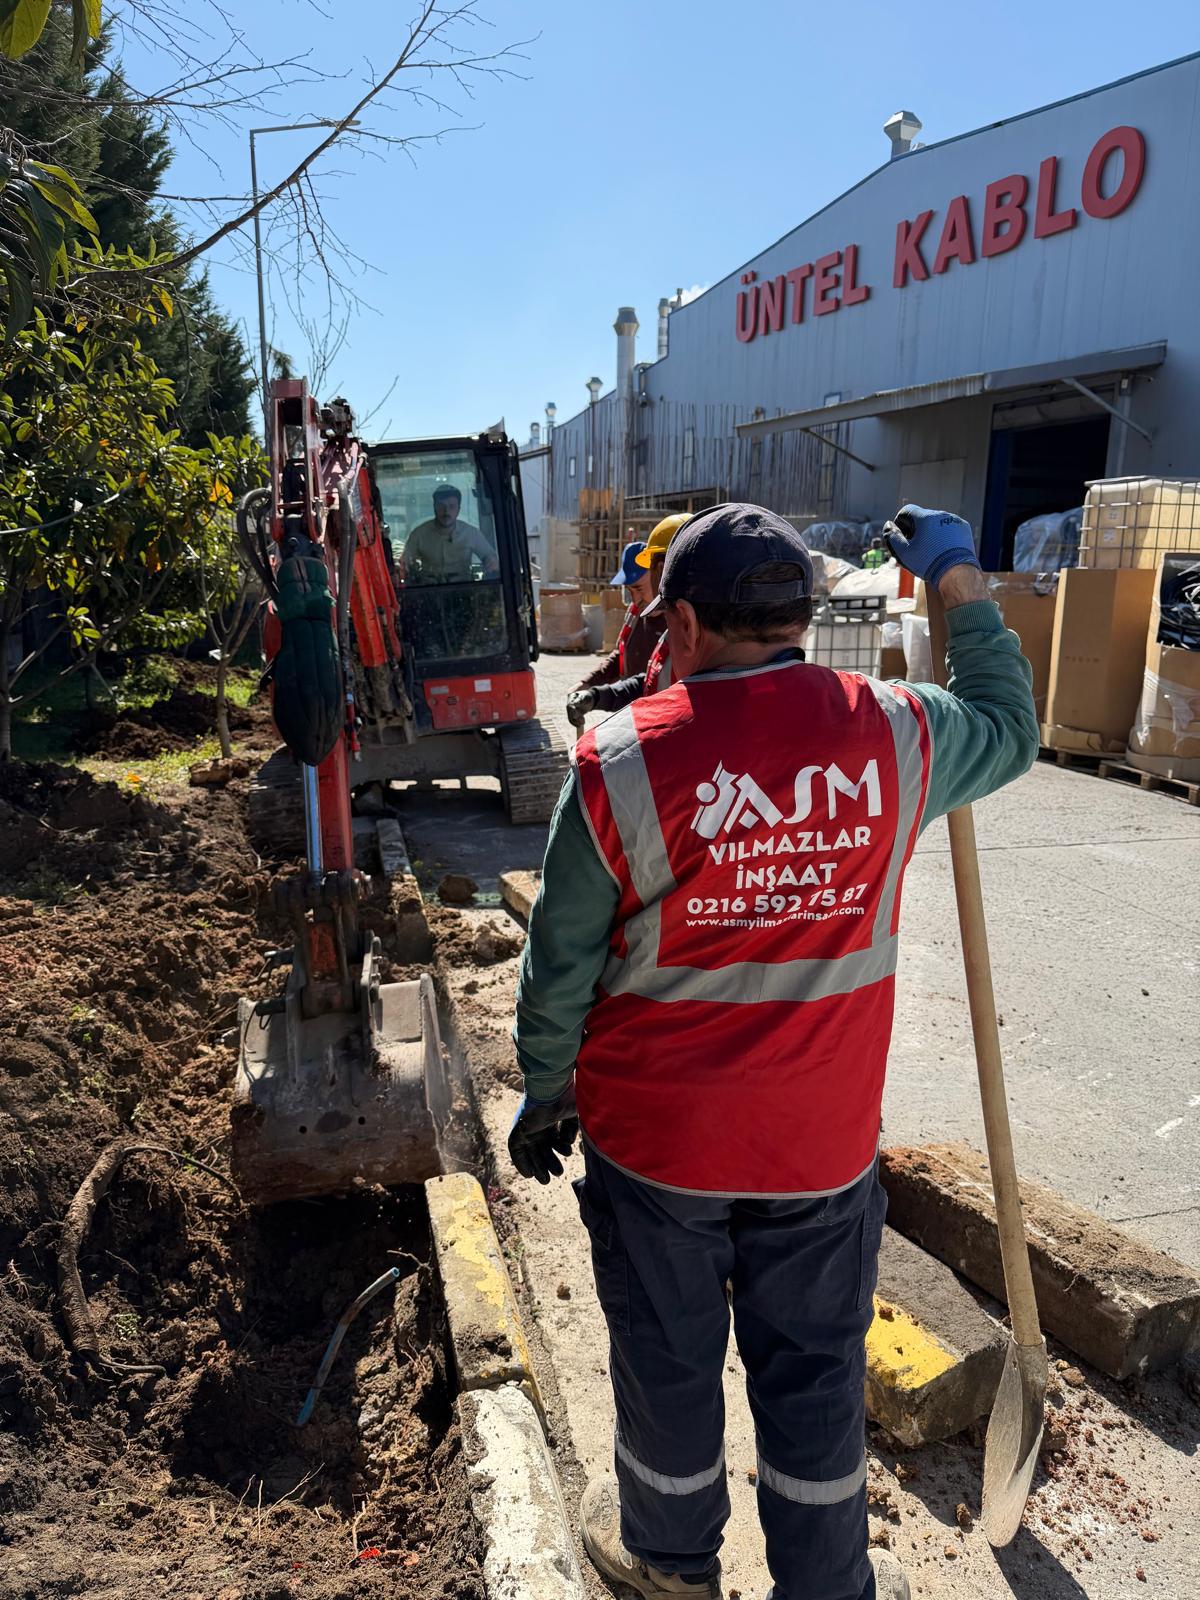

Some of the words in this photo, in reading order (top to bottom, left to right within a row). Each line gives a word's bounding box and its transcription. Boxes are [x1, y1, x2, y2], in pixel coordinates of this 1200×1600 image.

[735, 243, 870, 343] ÜNTEL
[893, 125, 1146, 288] KABLO
[723, 758, 882, 835] ASM
[708, 826, 871, 865] YILMAZLAR
[735, 862, 838, 892] İNŞAAT
[687, 896, 747, 914] 0216
[754, 894, 802, 913] 592
